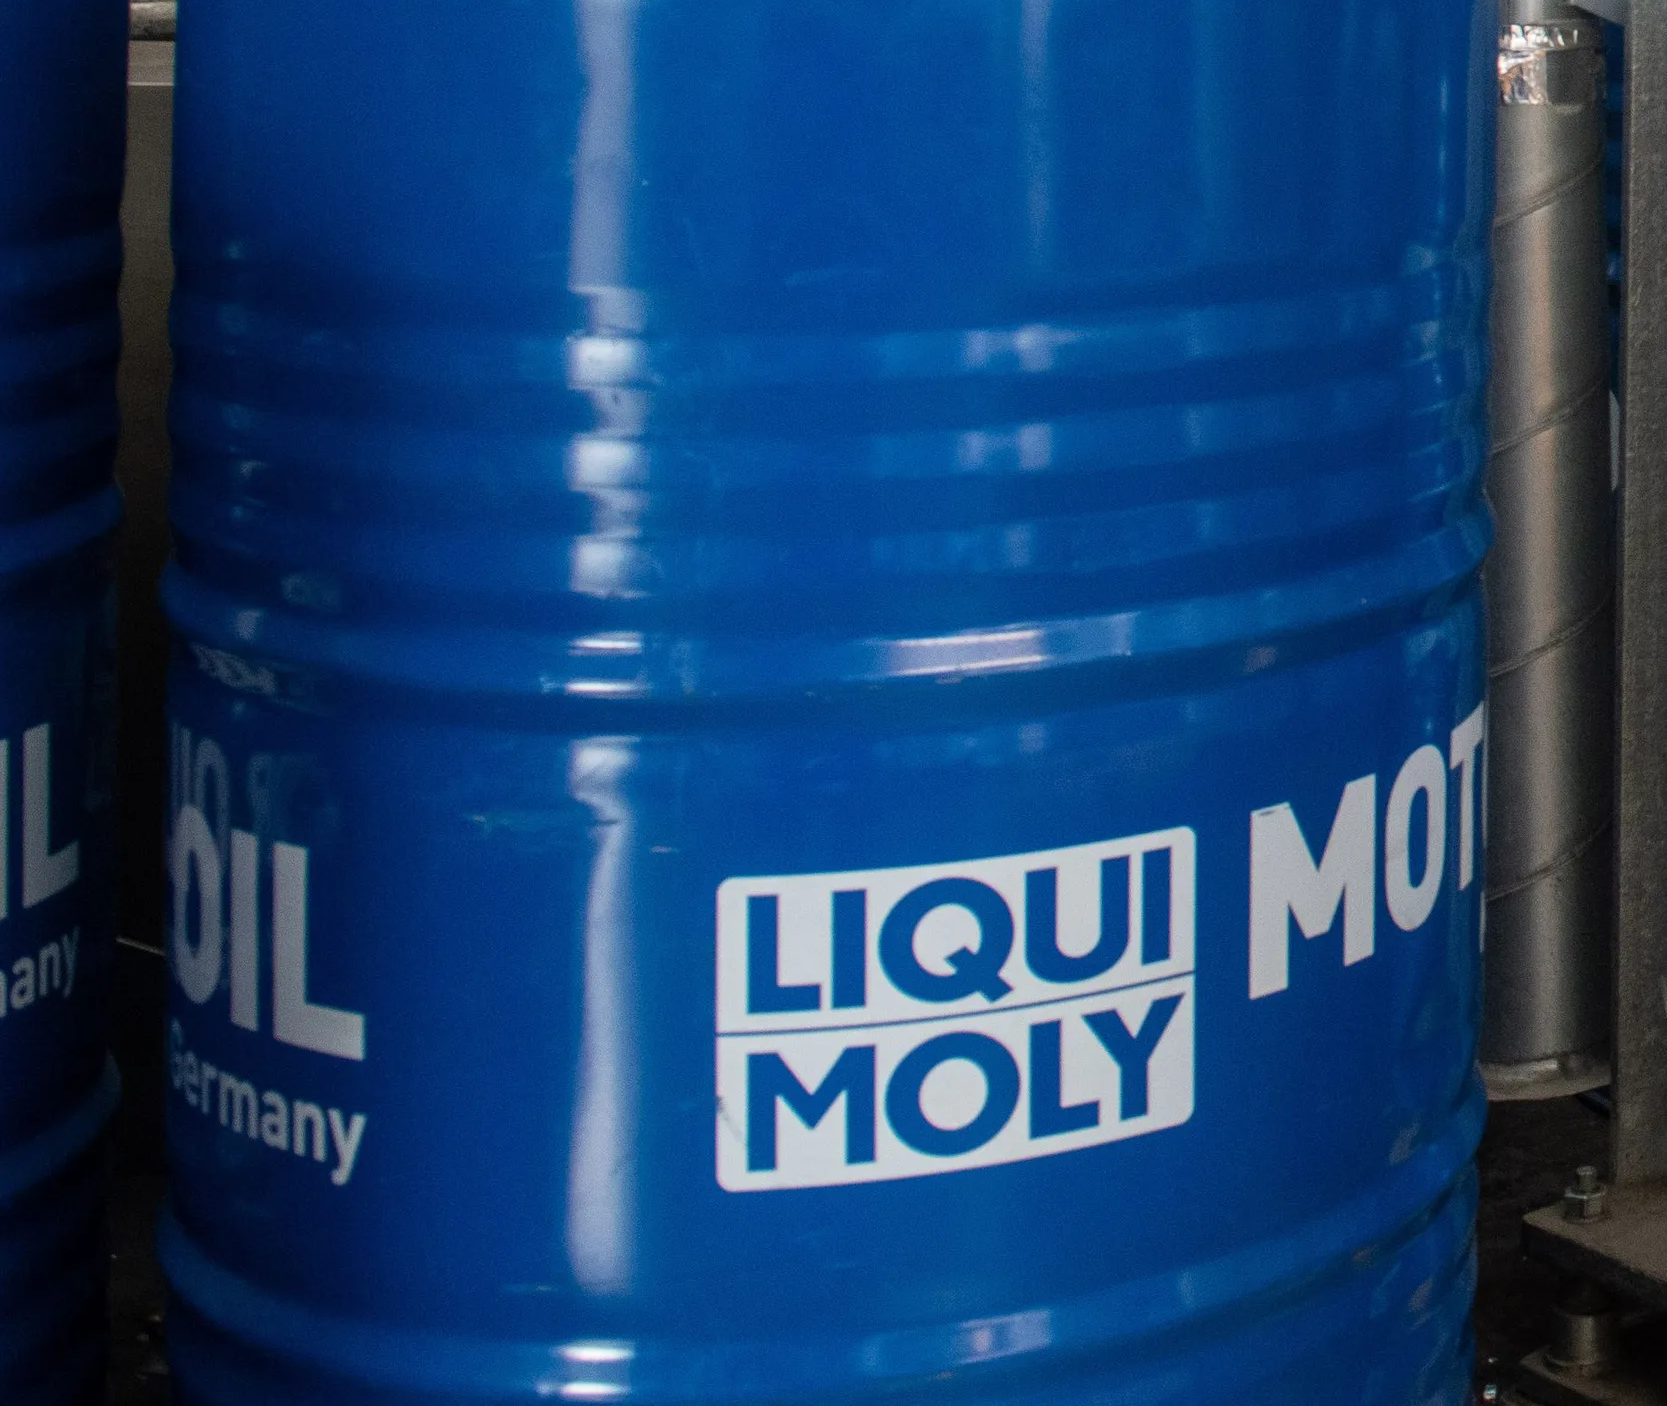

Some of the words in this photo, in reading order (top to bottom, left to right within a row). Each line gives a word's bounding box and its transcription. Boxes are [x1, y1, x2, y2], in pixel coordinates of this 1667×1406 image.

[171, 805, 365, 1061] OIL
[746, 845, 1173, 1016] LIQUI
[1249, 700, 1486, 1001] MOT
[0, 925, 80, 1019] any
[746, 993, 1187, 1174] MOLY
